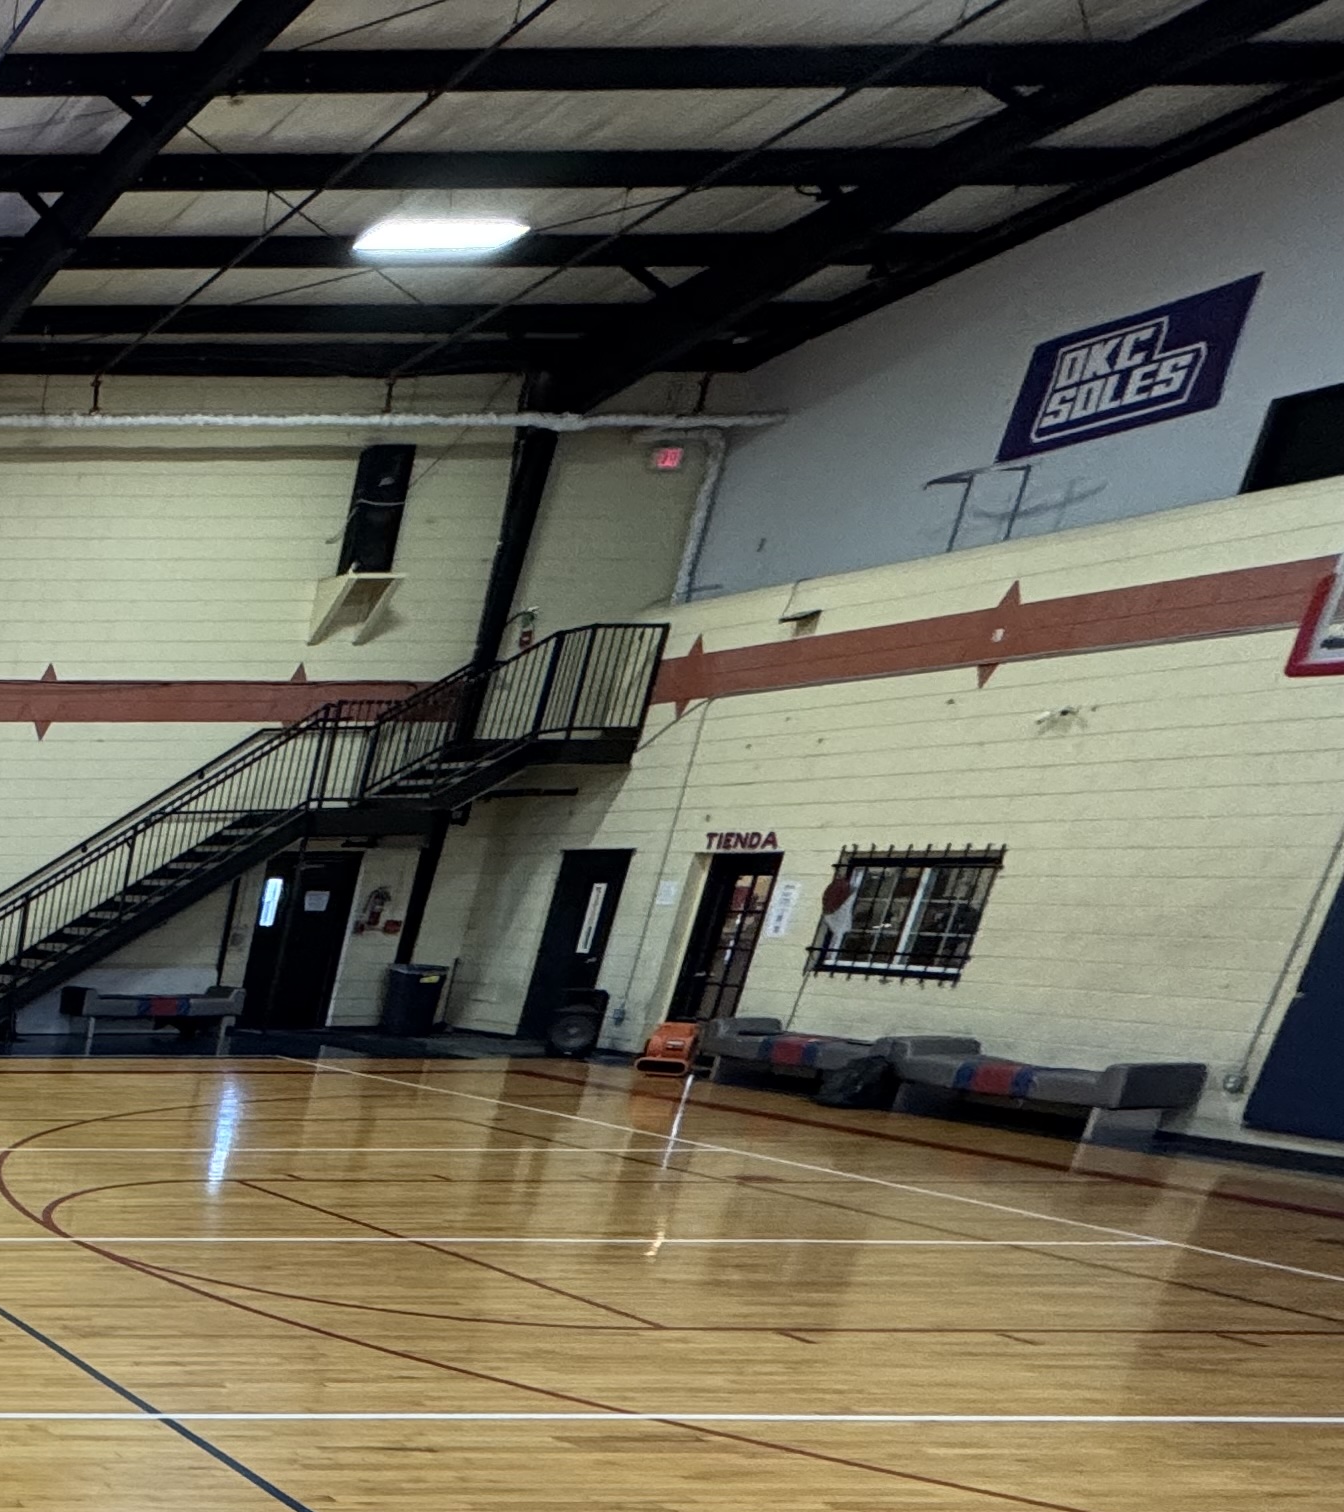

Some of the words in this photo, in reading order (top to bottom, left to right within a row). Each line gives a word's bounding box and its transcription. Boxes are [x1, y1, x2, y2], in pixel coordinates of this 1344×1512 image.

[1055, 326, 1156, 390] OKC
[1039, 354, 1194, 430] SOLES
[706, 831, 778, 849] TIENDA
